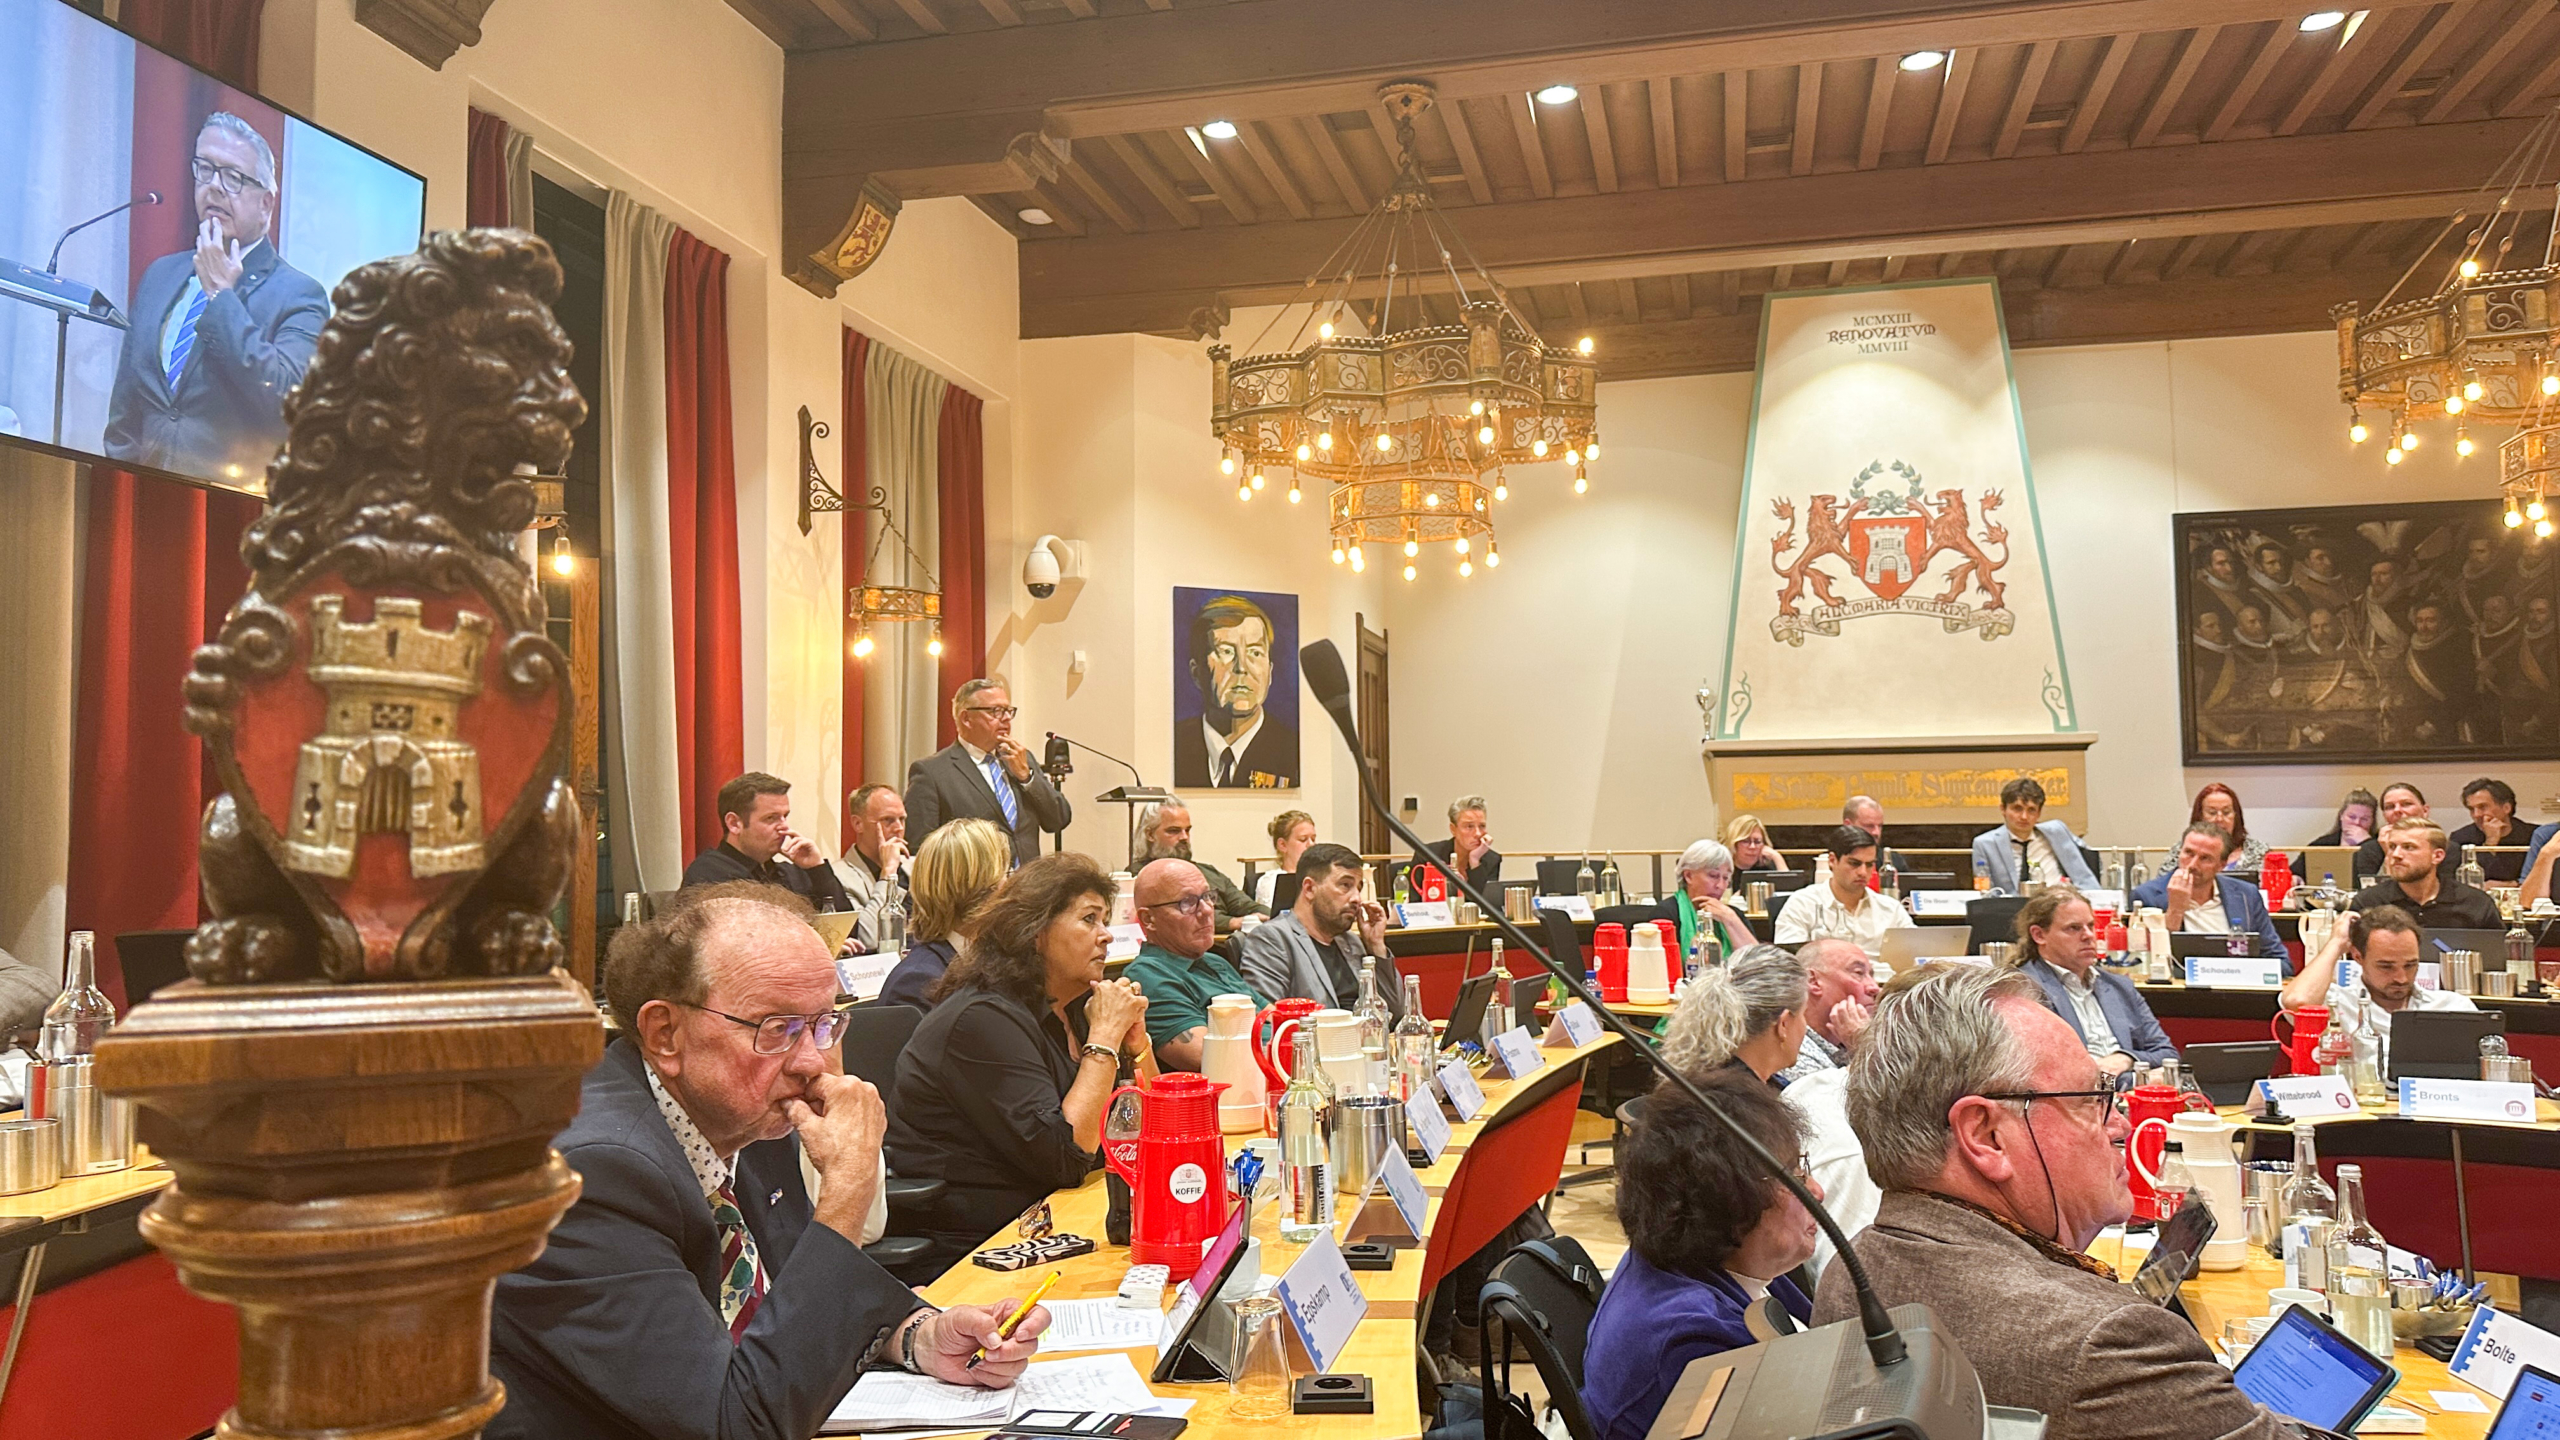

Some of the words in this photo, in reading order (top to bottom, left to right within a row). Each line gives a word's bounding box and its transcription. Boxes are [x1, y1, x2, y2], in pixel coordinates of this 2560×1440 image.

[1853, 313, 1912, 327] MCMXIII
[1857, 341, 1909, 354] MMVIII
[2276, 1090, 2322, 1101] Wittebrood
[2419, 1091, 2460, 1102] Bronts
[1175, 1186, 1202, 1196] KOFFIE
[1301, 1284, 1332, 1324] Epskamp
[2483, 1338, 2516, 1364] Bolte
